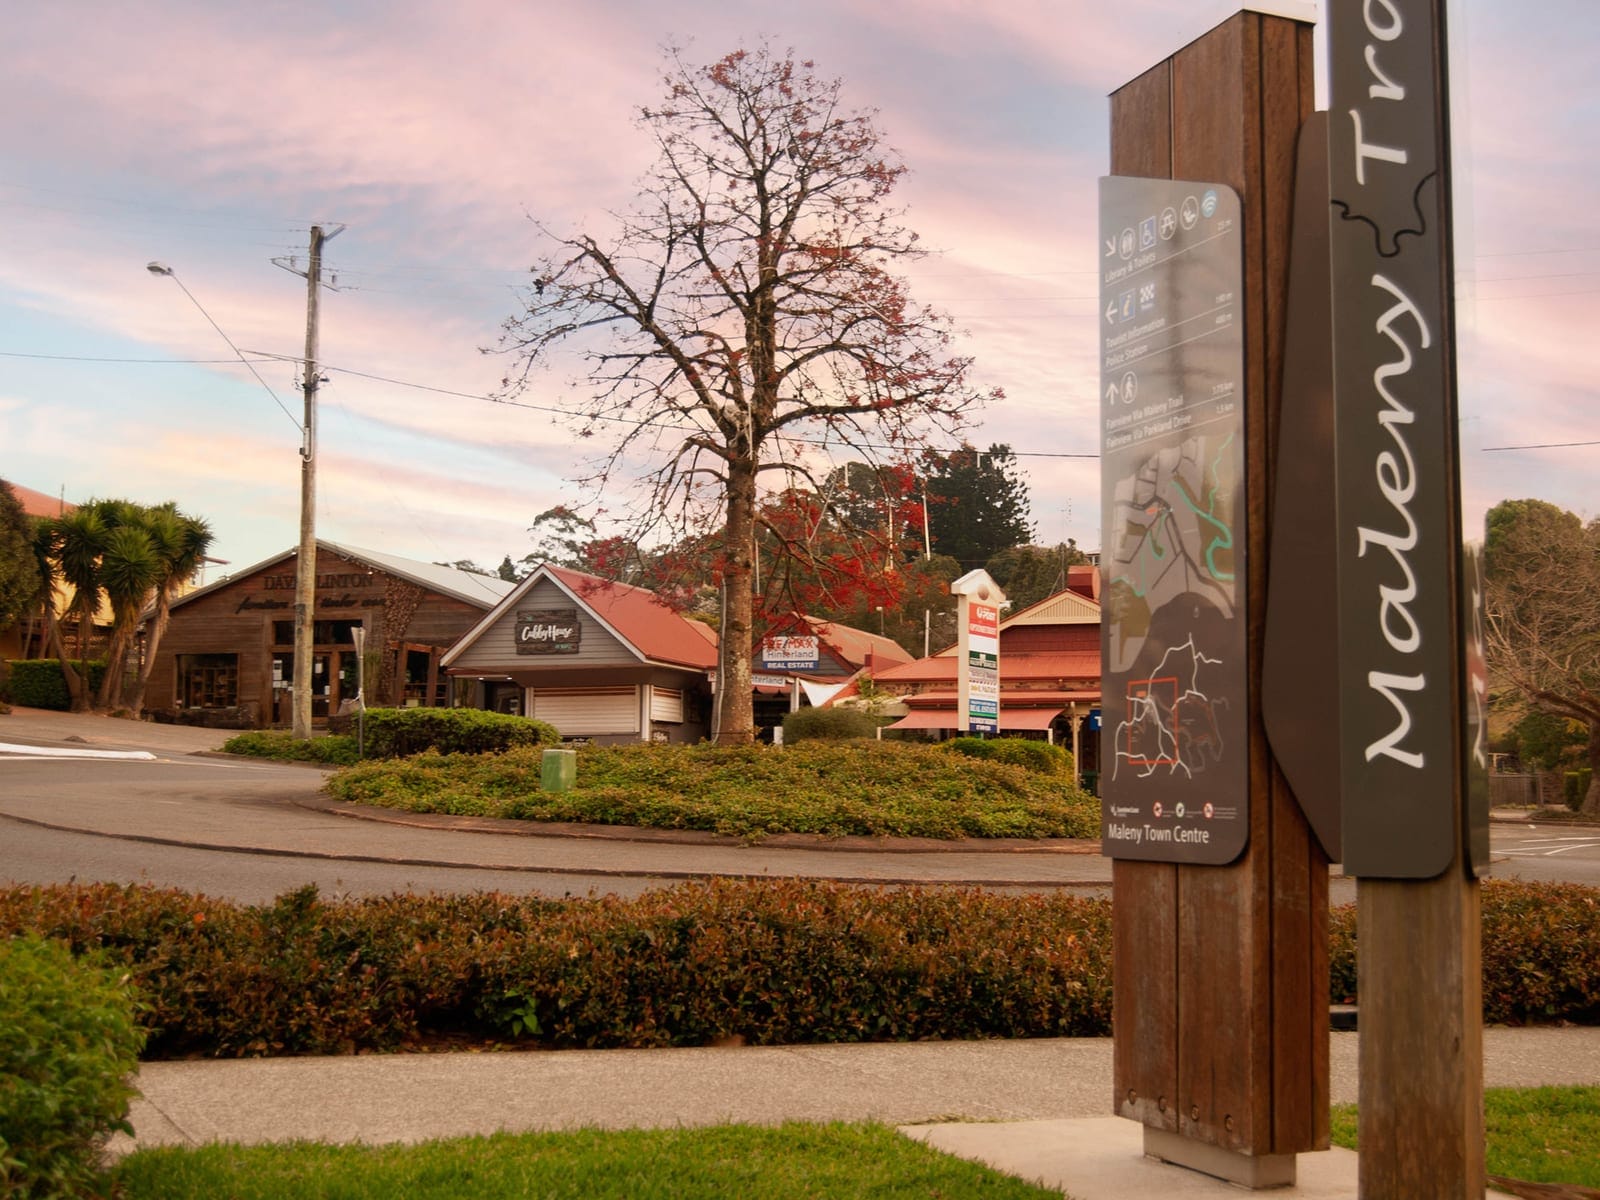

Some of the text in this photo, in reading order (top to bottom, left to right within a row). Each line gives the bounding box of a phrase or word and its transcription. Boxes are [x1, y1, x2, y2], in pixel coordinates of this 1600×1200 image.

[1105, 266, 1127, 283] Library
[1134, 252, 1156, 268] Toilets
[1106, 333, 1128, 349] Tourist
[1128, 318, 1165, 340] Information
[1106, 353, 1125, 368] Police
[1125, 345, 1148, 361] Station
[1168, 394, 1183, 408] Trail
[1173, 414, 1192, 429] Drive
[1358, 274, 1431, 769] Maleny
[1108, 823, 1210, 844] Maleny Town Centre
